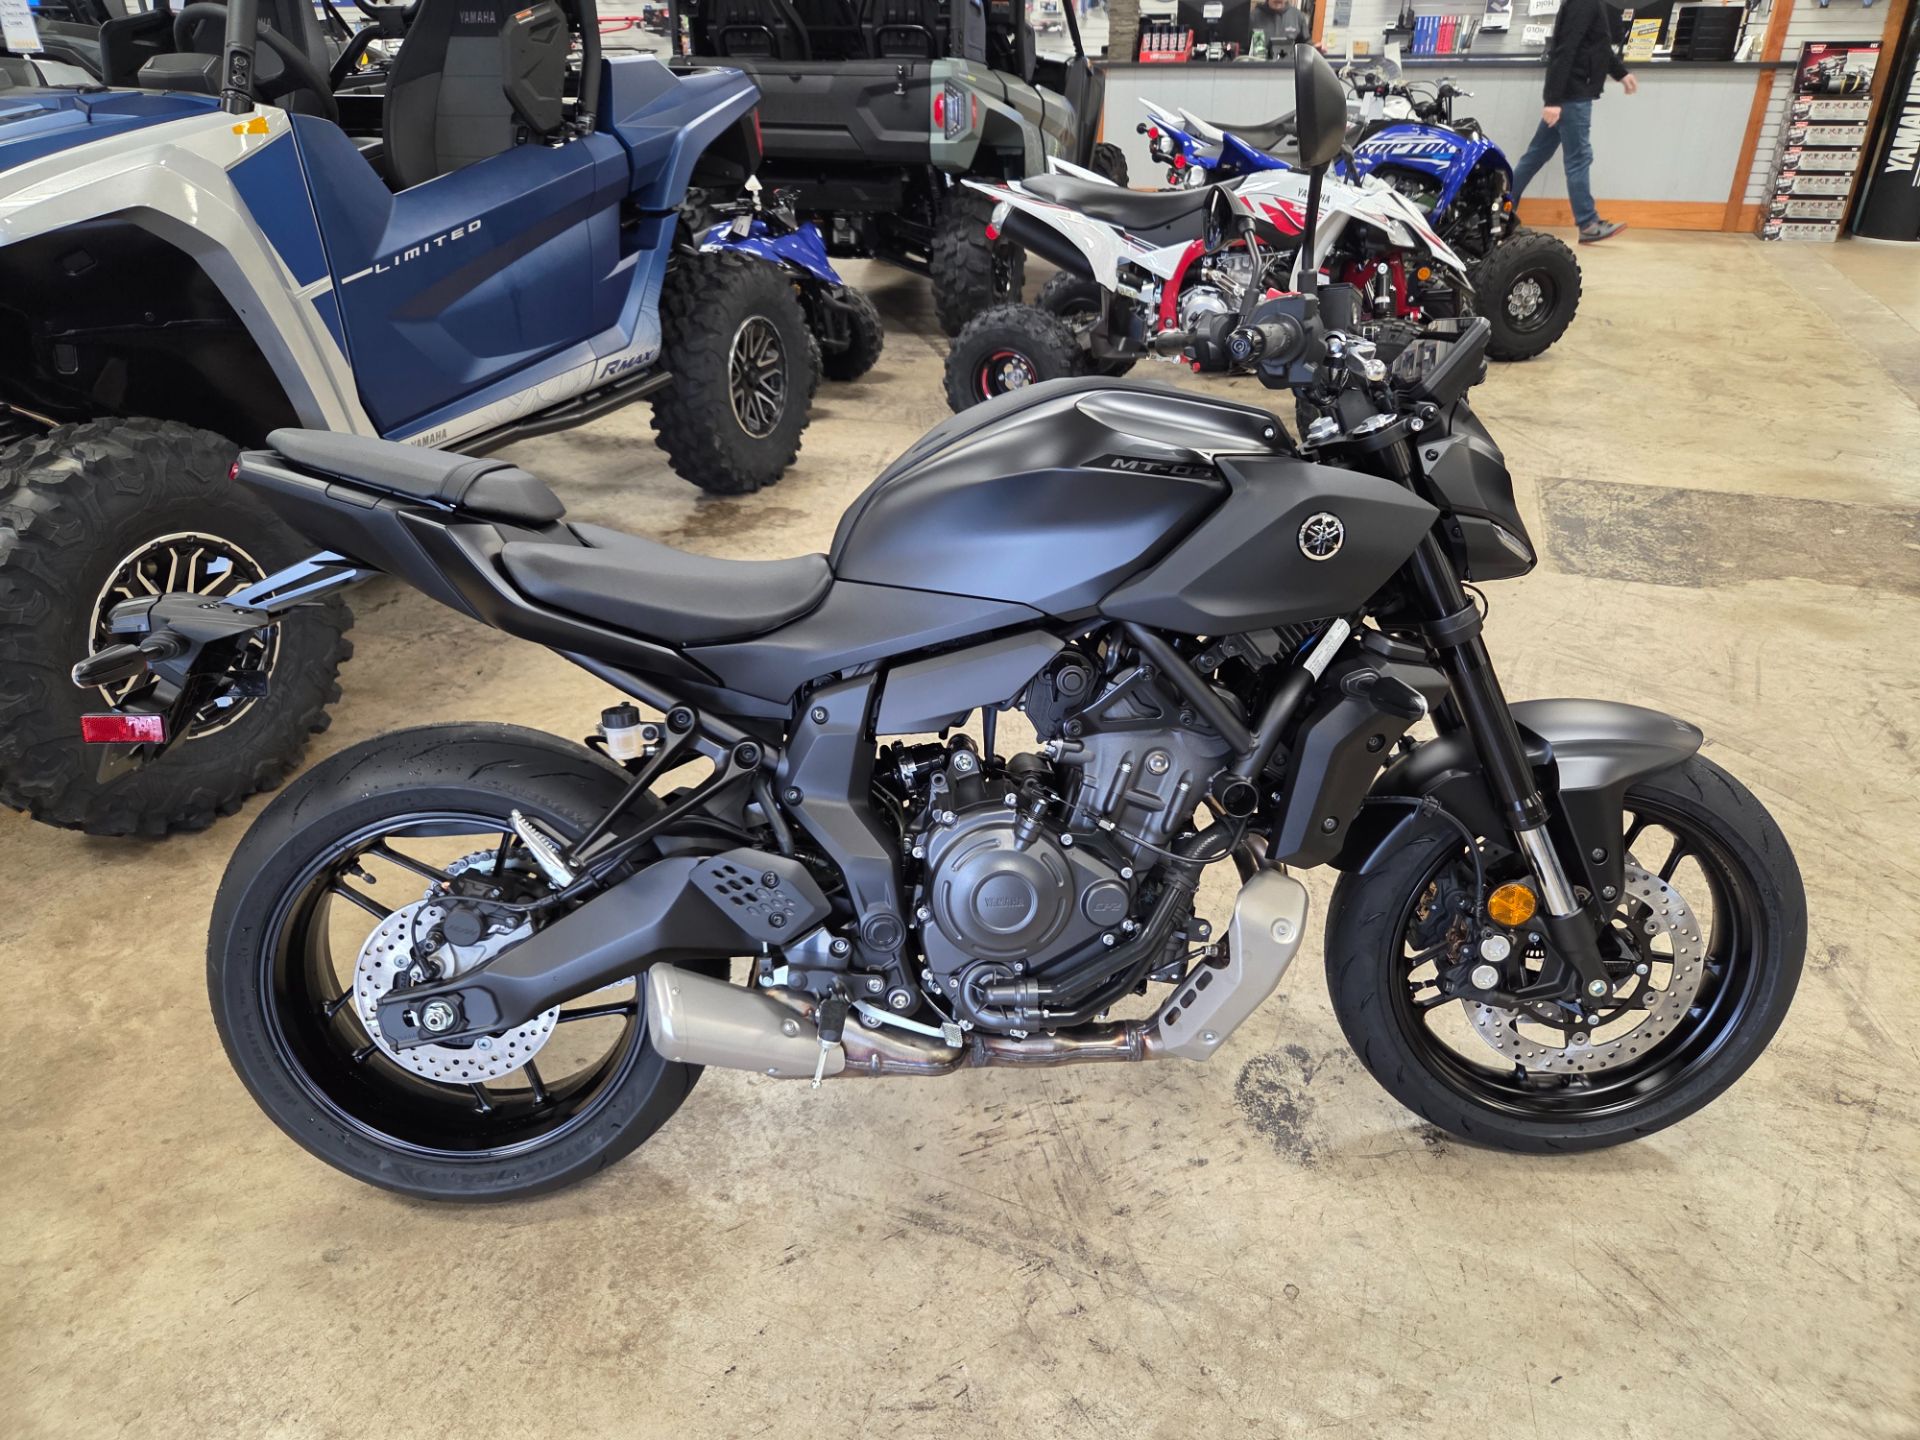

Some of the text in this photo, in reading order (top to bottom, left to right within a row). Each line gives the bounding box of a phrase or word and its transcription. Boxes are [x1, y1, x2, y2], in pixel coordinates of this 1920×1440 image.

[459, 11, 496, 24] YAMAHA
[1297, 186, 1331, 205] YAHA
[375, 219, 482, 274] LIMITED
[984, 895, 1025, 909] YAMAHA
